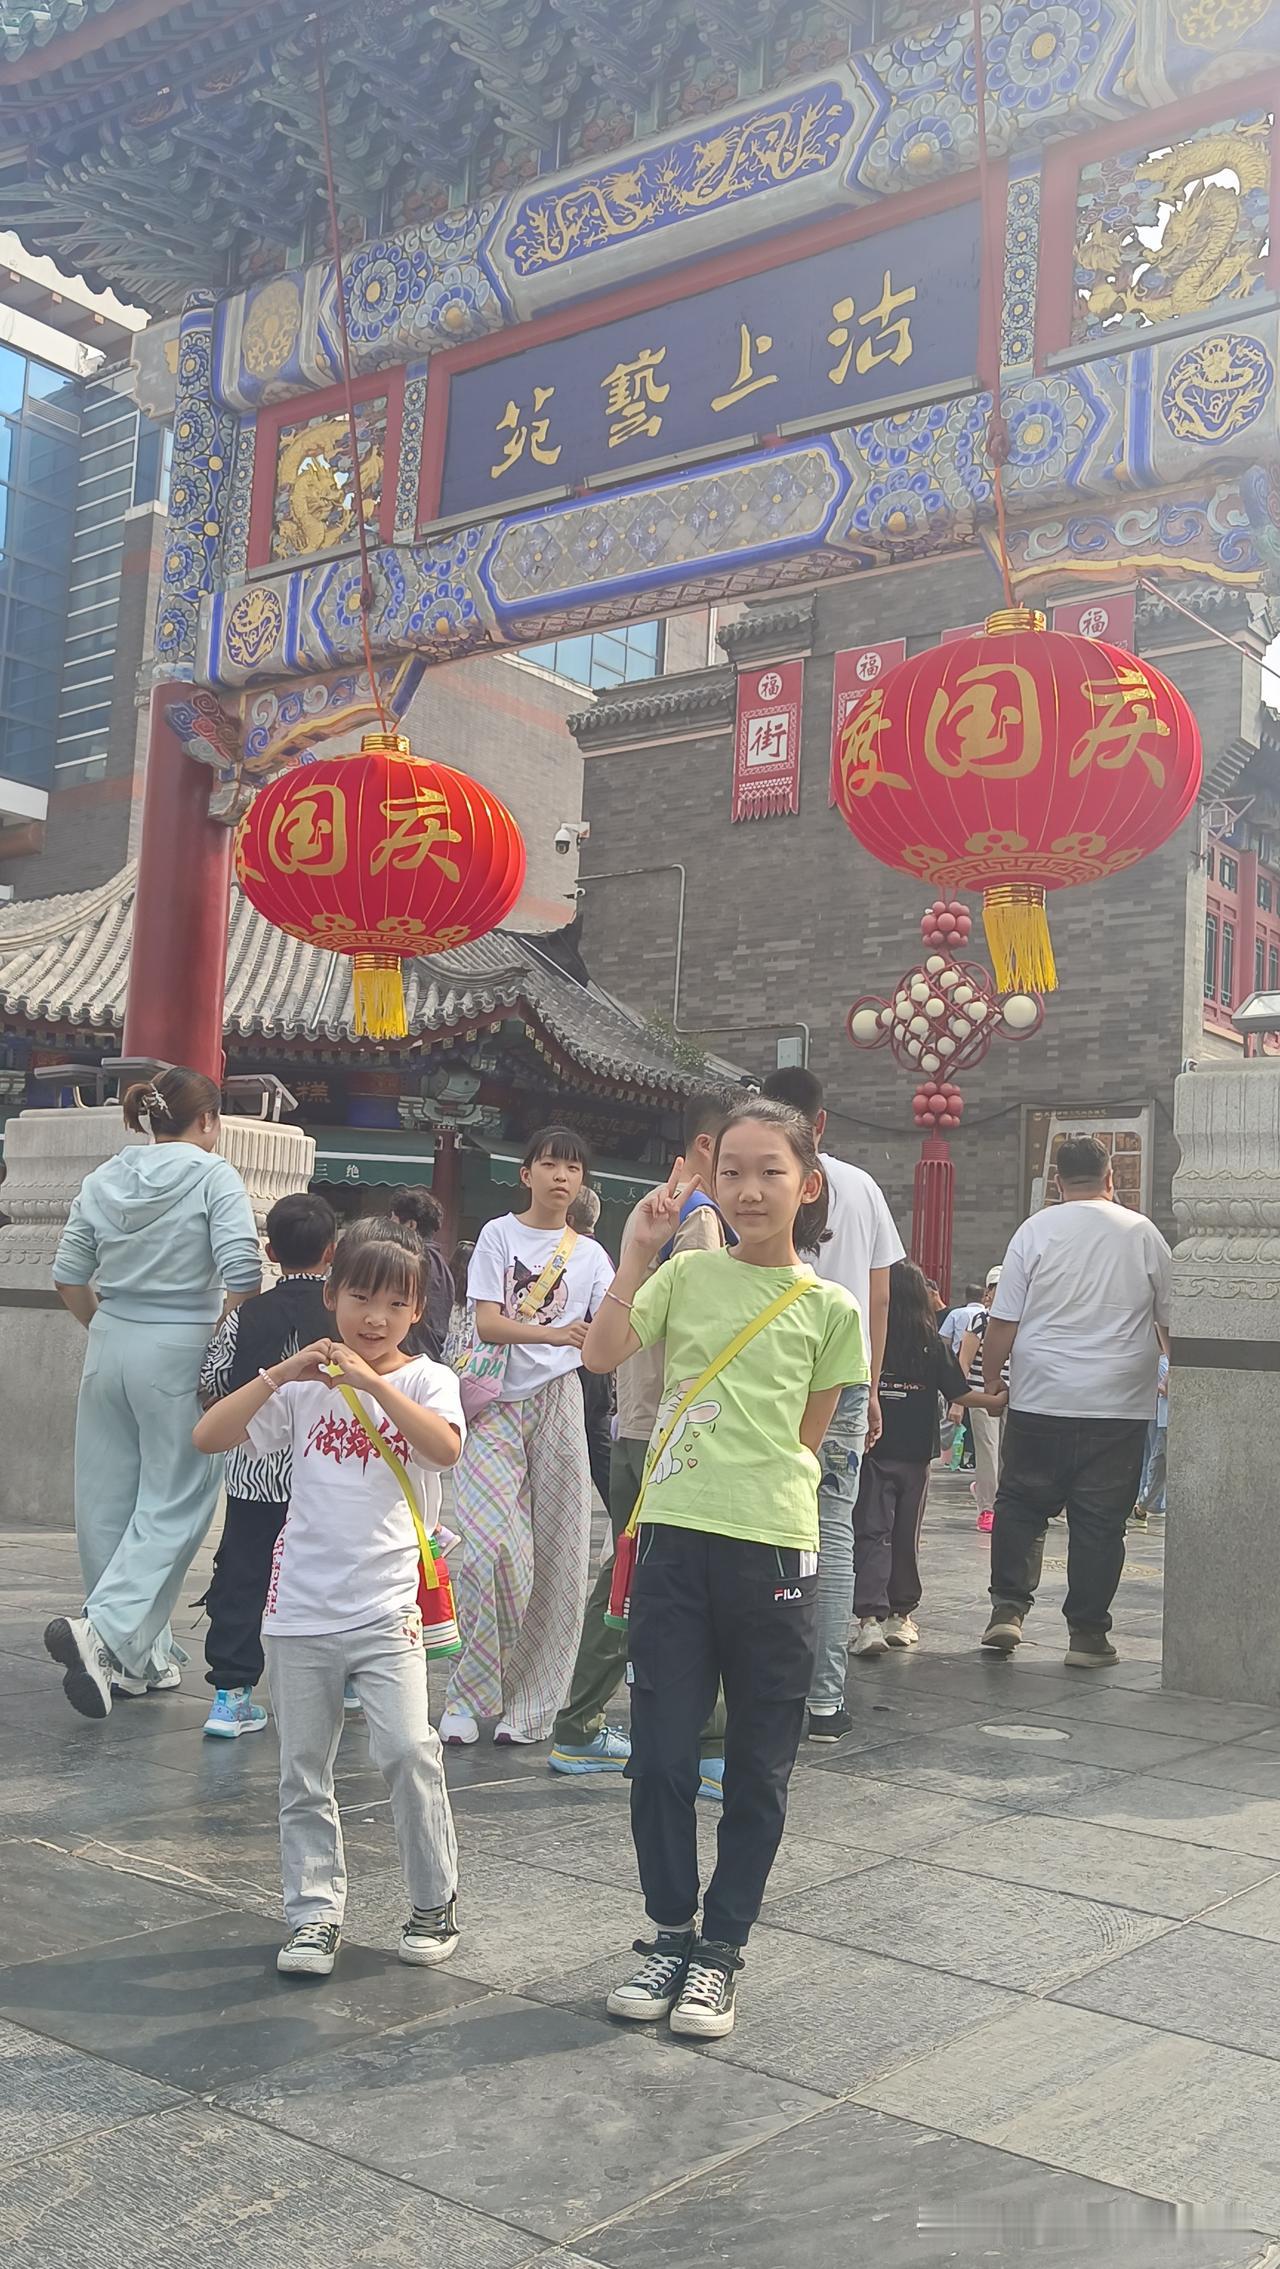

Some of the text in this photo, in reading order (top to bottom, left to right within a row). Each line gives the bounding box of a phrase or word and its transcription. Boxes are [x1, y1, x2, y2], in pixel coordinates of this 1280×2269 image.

[858, 654, 880, 680] 福
[760, 674, 781, 698] 福
[748, 719, 787, 758] 街
[773, 1586, 803, 1602] FILA
